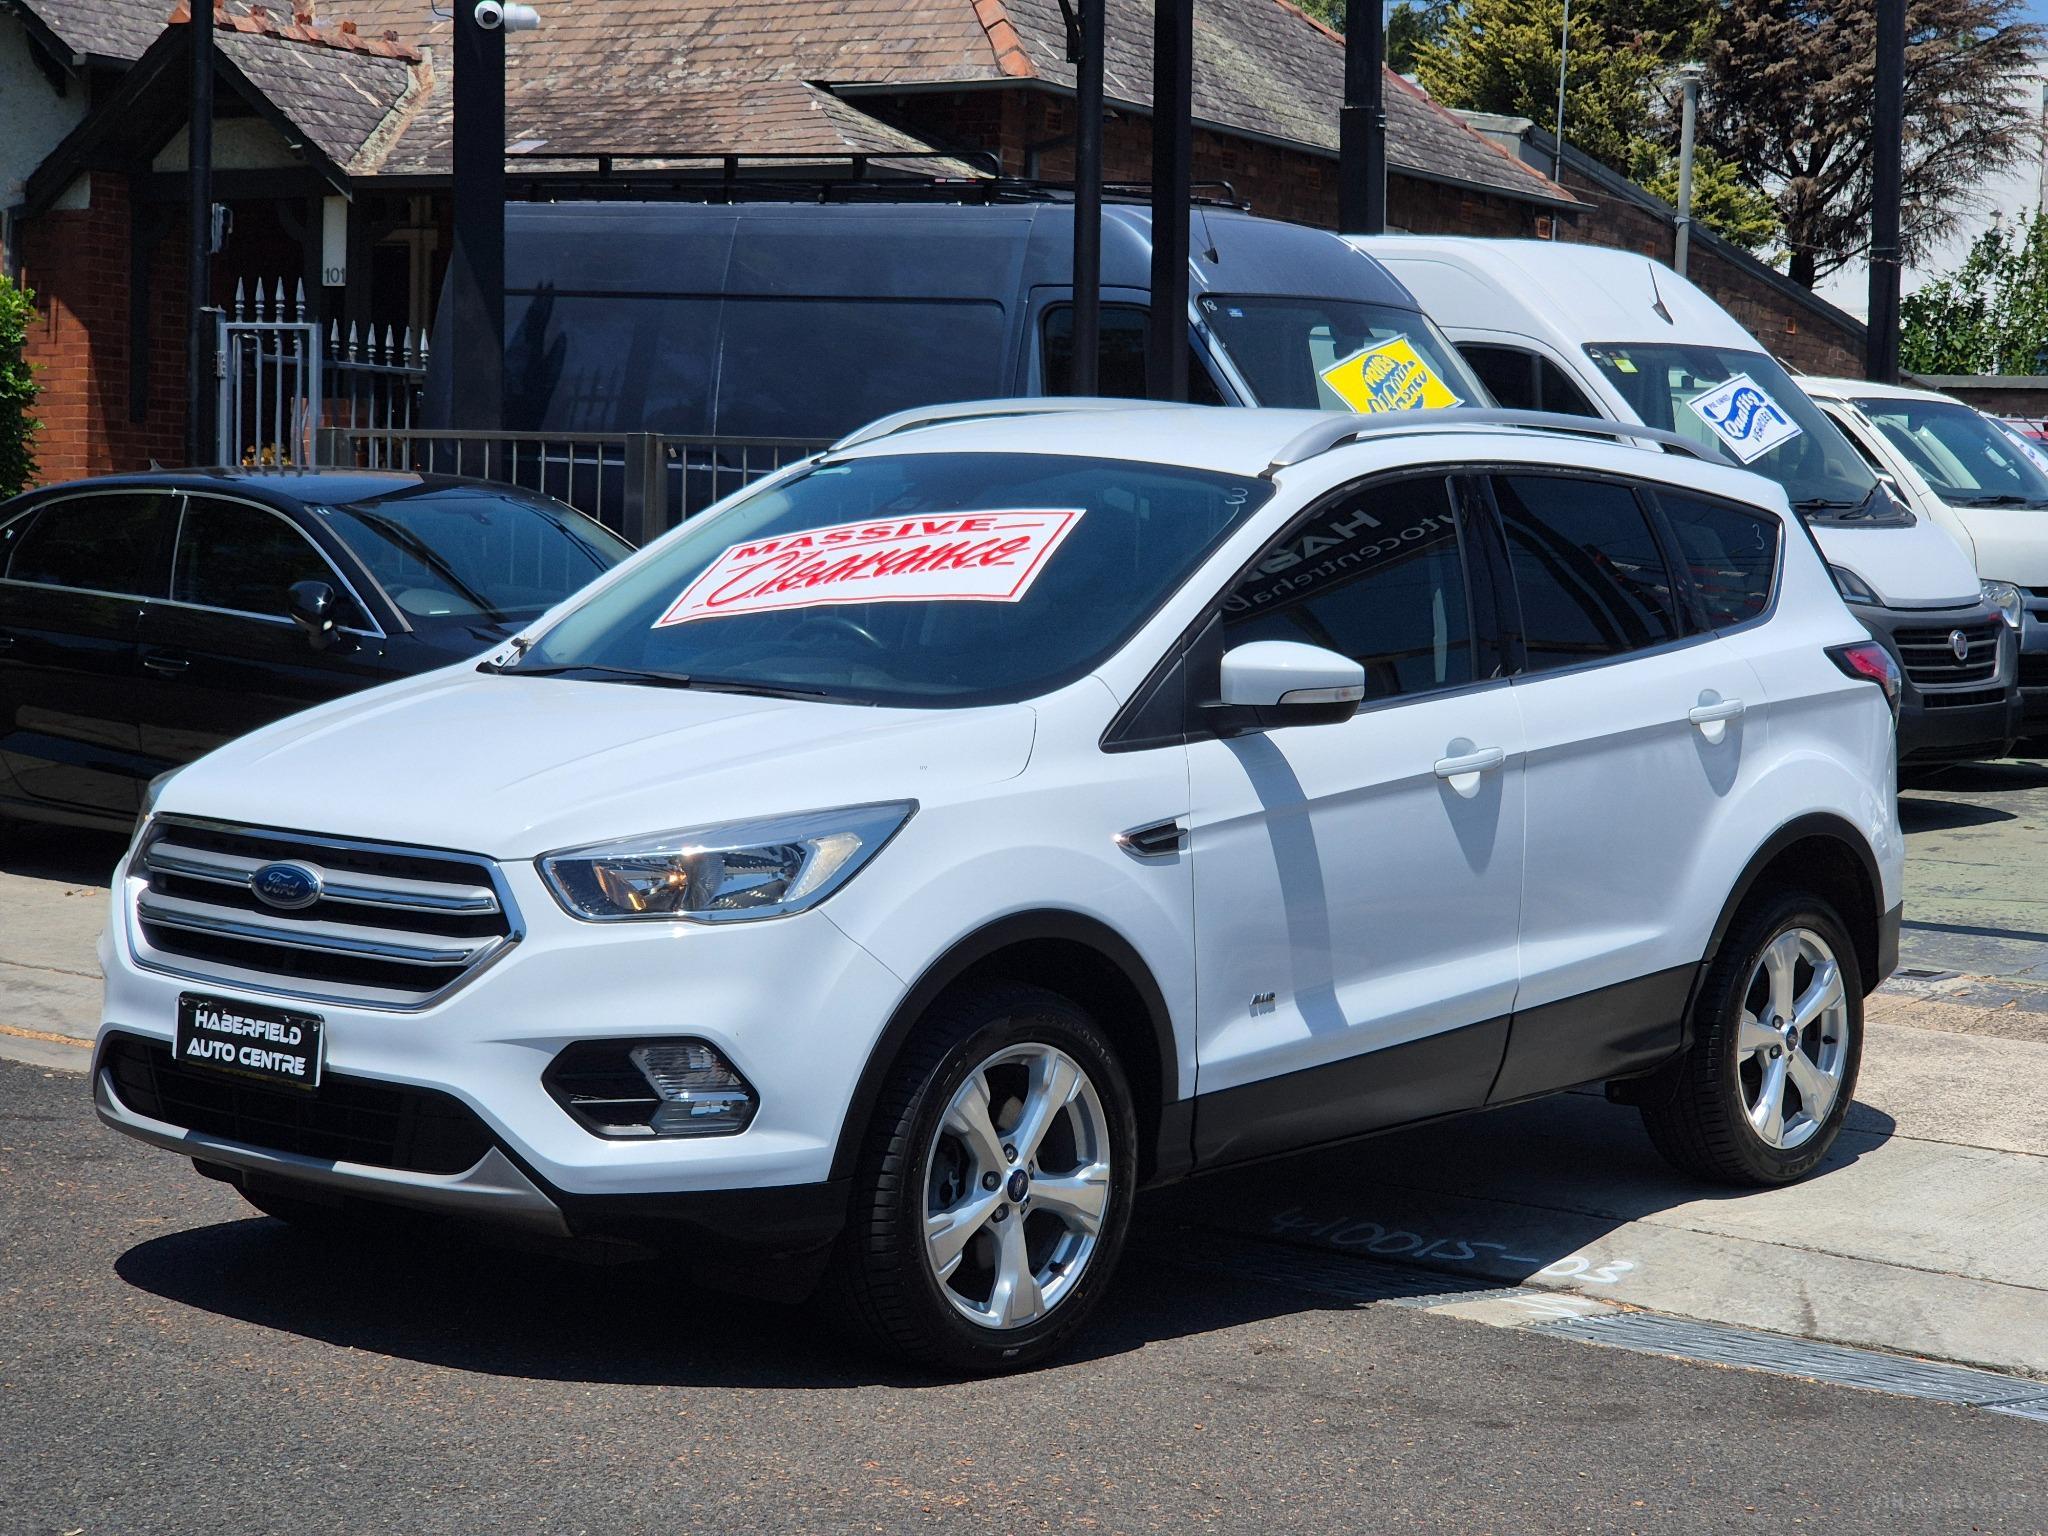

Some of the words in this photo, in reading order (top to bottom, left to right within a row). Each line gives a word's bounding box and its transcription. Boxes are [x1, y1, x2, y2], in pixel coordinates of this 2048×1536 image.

[325, 267, 345, 284] 101
[732, 517, 999, 560] MASSIVE
[708, 535, 1032, 608] Clearance
[264, 872, 301, 897] Ford
[194, 1009, 302, 1046] HABERFIELD
[186, 1037, 236, 1062] AUTO
[238, 1046, 306, 1076] CENTRE
